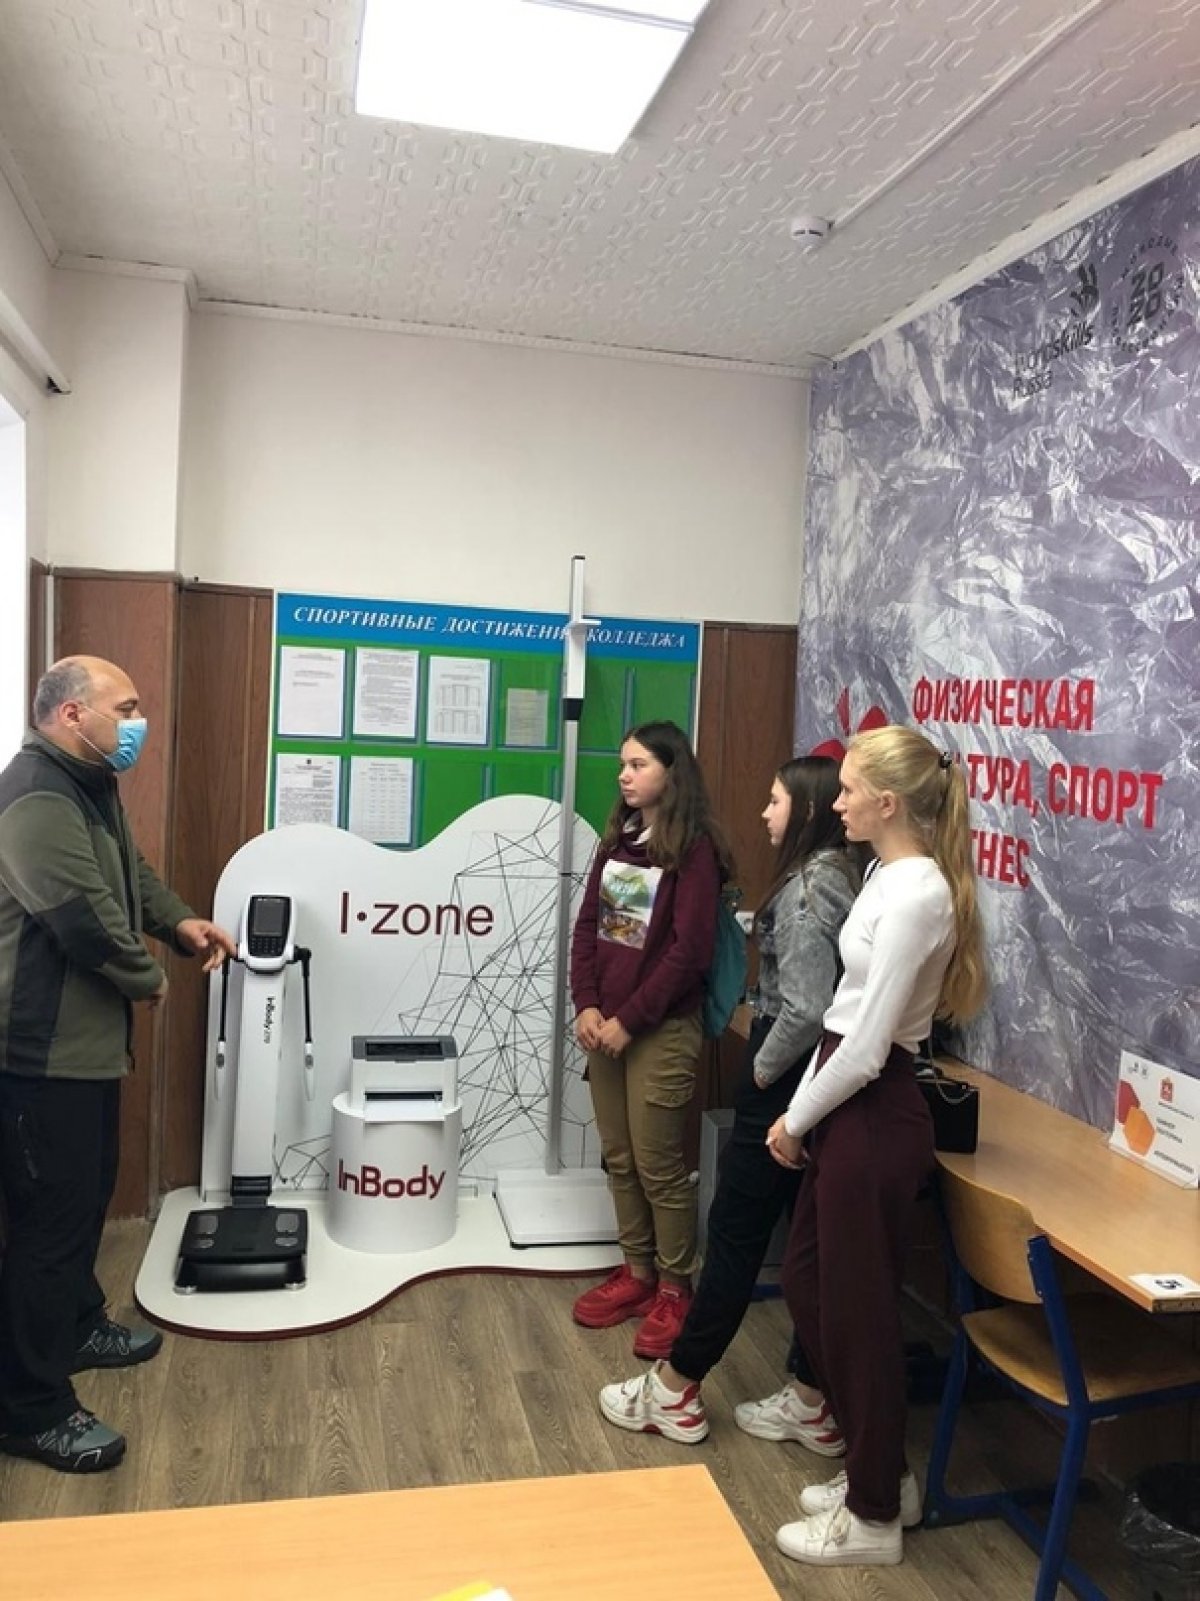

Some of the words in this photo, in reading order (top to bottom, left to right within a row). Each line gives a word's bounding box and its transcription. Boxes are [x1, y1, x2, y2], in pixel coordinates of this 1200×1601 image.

[294, 606, 437, 630] СПОРТИВНЫЕ
[440, 616, 568, 640] ДОСТИЖЕНИ
[586, 627, 686, 648] КОЛЛЕДЖА
[912, 675, 1096, 731] ФИЗИЧЕСКАЯ
[953, 751, 1040, 818] ТУРА,
[1047, 761, 1164, 833] СПОРТ
[969, 828, 1031, 889] НЕС
[338, 1159, 447, 1200] InBody
